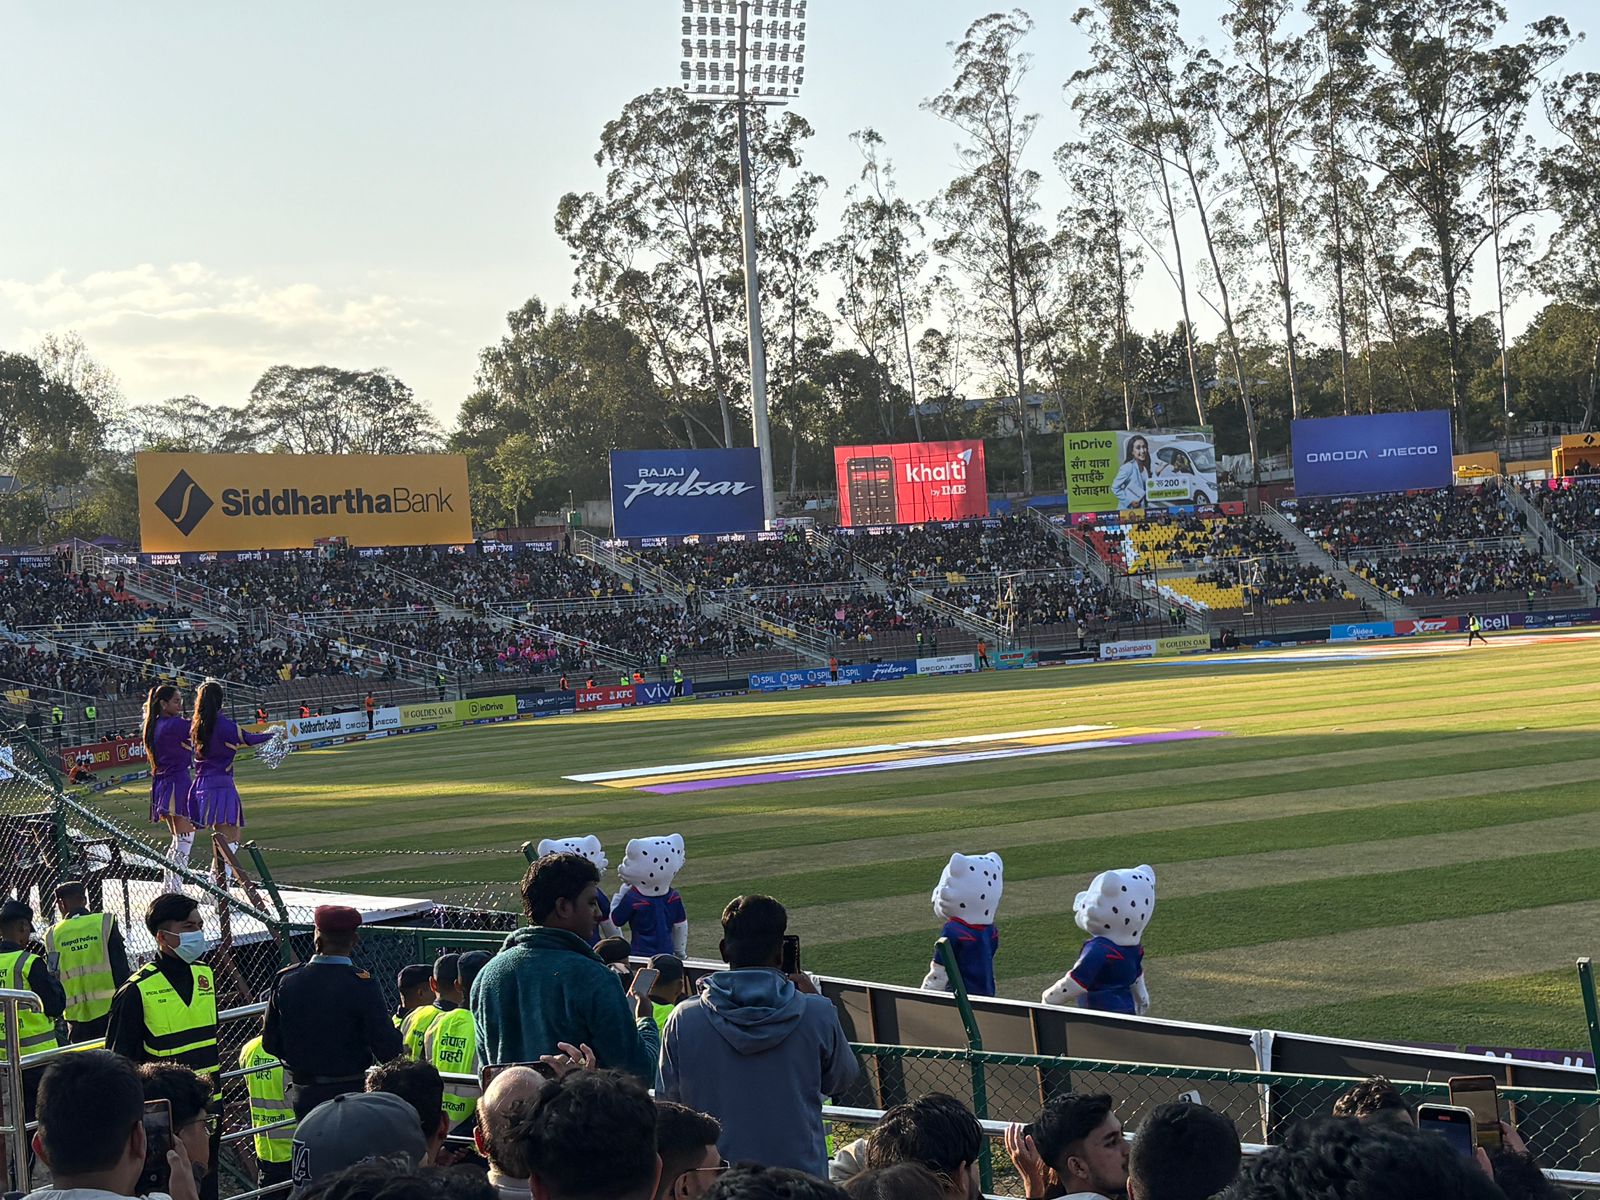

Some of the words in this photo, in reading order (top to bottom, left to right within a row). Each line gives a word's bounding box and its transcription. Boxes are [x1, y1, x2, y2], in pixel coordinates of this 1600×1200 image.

[1069, 438, 1112, 450] inDrive
[1306, 450, 1368, 462] OMODA
[1378, 445, 1438, 457] JAECOO
[638, 467, 685, 478] BAJAJ
[905, 460, 966, 482] khalti
[623, 467, 756, 509] pulsar
[930, 489, 940, 497] by
[941, 485, 966, 495] IME
[1166, 640, 1192, 649] GOLDEN
[760, 676, 775, 684] SPIL
[790, 673, 804, 682] SPIL
[817, 671, 832, 679] SPIL
[845, 668, 860, 677] SPIL
[586, 692, 603, 702] KFC
[616, 690, 633, 699] KFC
[480, 702, 504, 711] inDrive
[517, 699, 526, 709] 22
[411, 708, 438, 719] GOLDEN
[439, 706, 453, 715] OAK
[441, 1033, 467, 1048] नेपाल
[440, 1049, 463, 1062] प्रहरी
